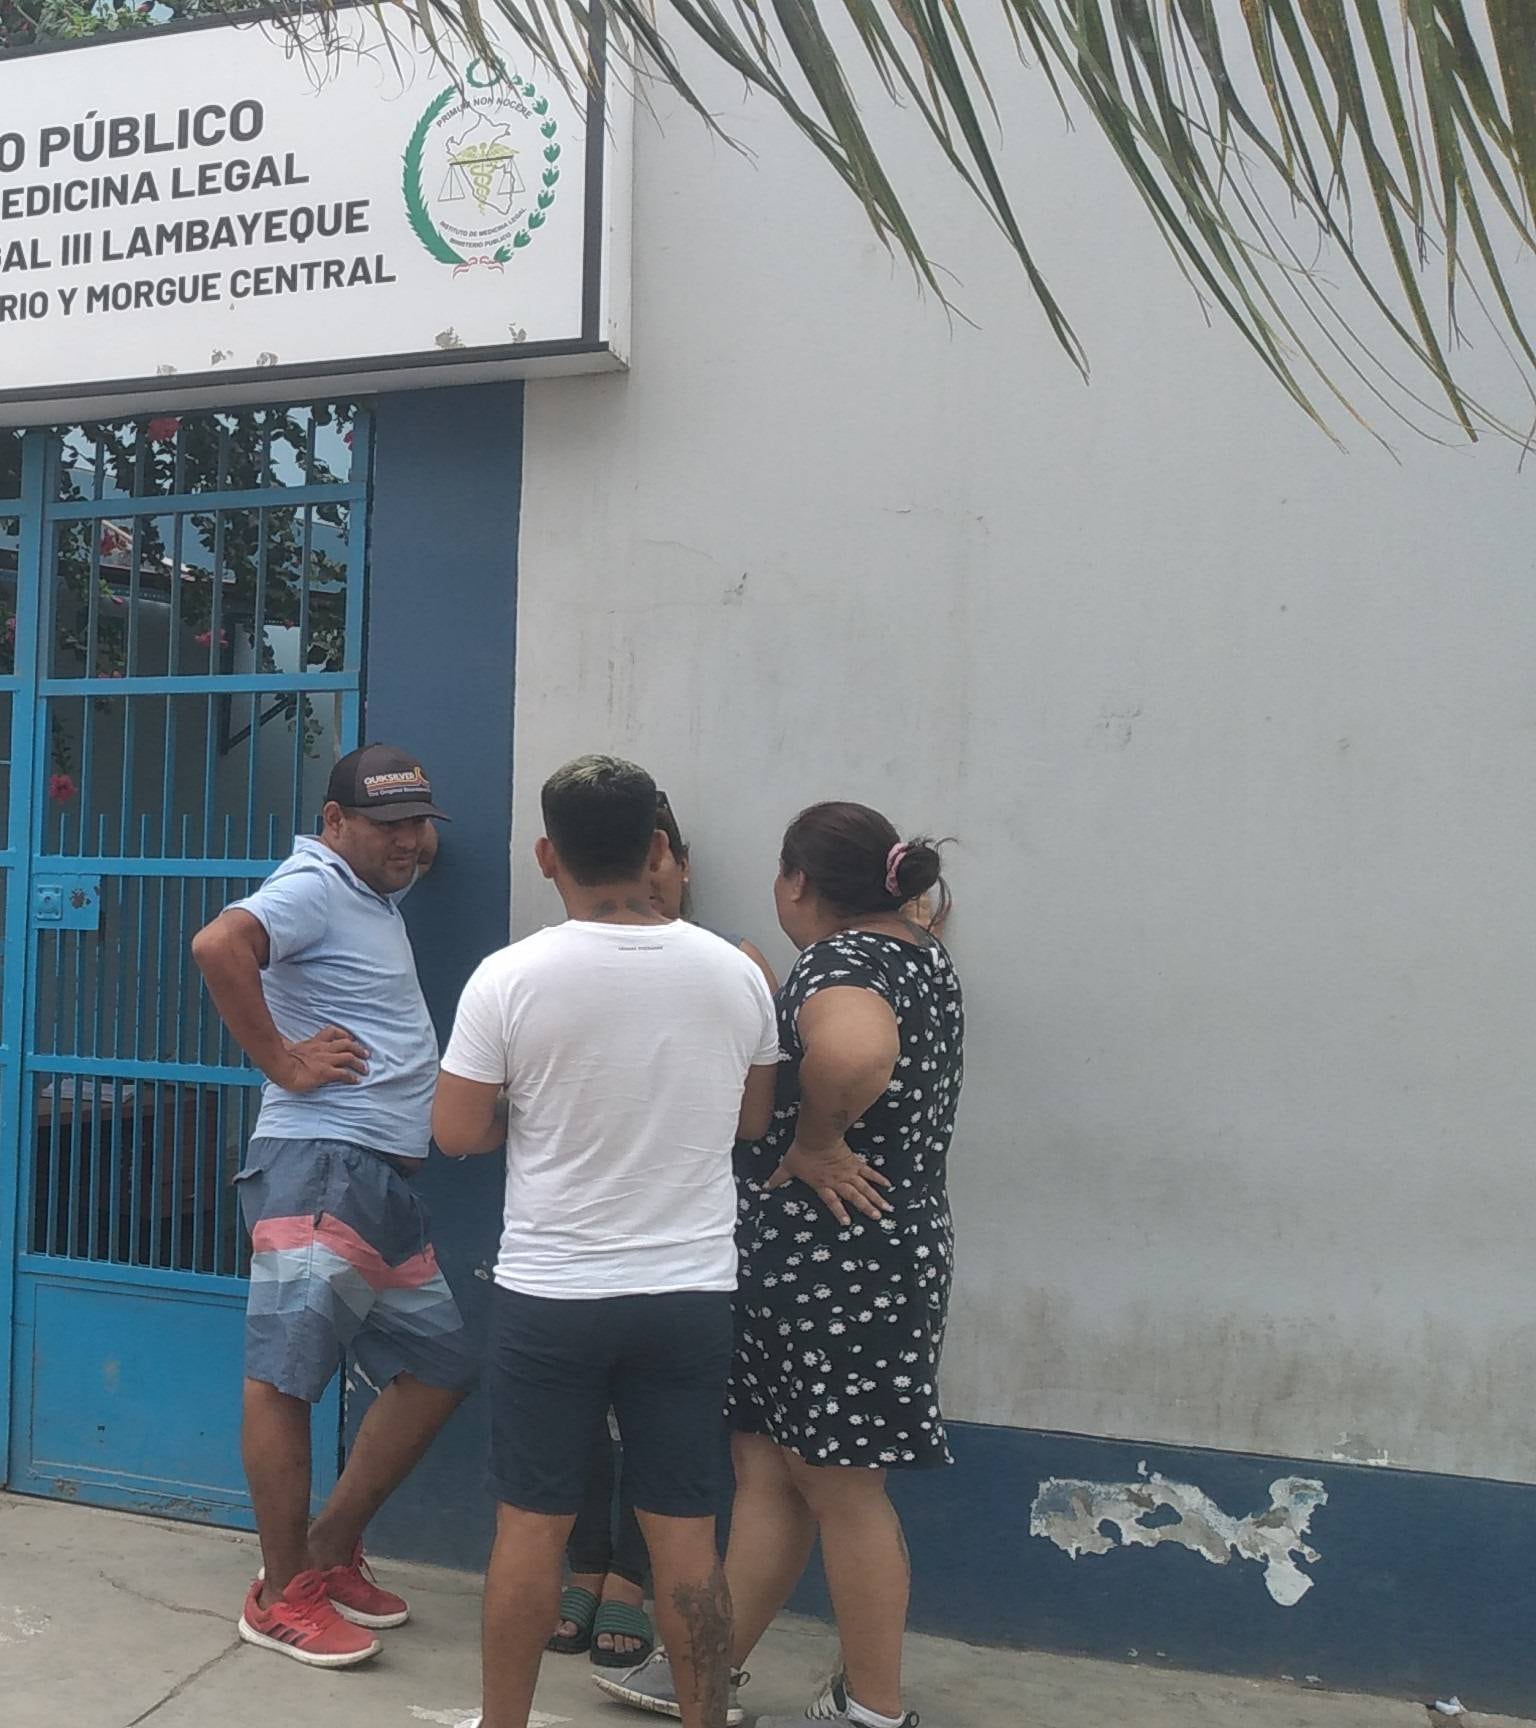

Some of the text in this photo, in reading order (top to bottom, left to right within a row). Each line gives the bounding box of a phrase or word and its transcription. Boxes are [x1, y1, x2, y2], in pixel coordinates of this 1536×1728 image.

[473, 97, 494, 107] NON
[495, 97, 533, 120] NOCERE
[39, 99, 264, 168] PÚBLICO
[171, 153, 310, 199] LEGAL
[61, 232, 92, 266] III
[102, 199, 370, 262] LAMBAYEQUE
[479, 222, 508, 237] MEDICINA
[58, 287, 78, 316] Y
[86, 272, 221, 313] MORGUE
[230, 254, 396, 299] CENTRAL
[364, 771, 415, 785] QUIKSILVER
